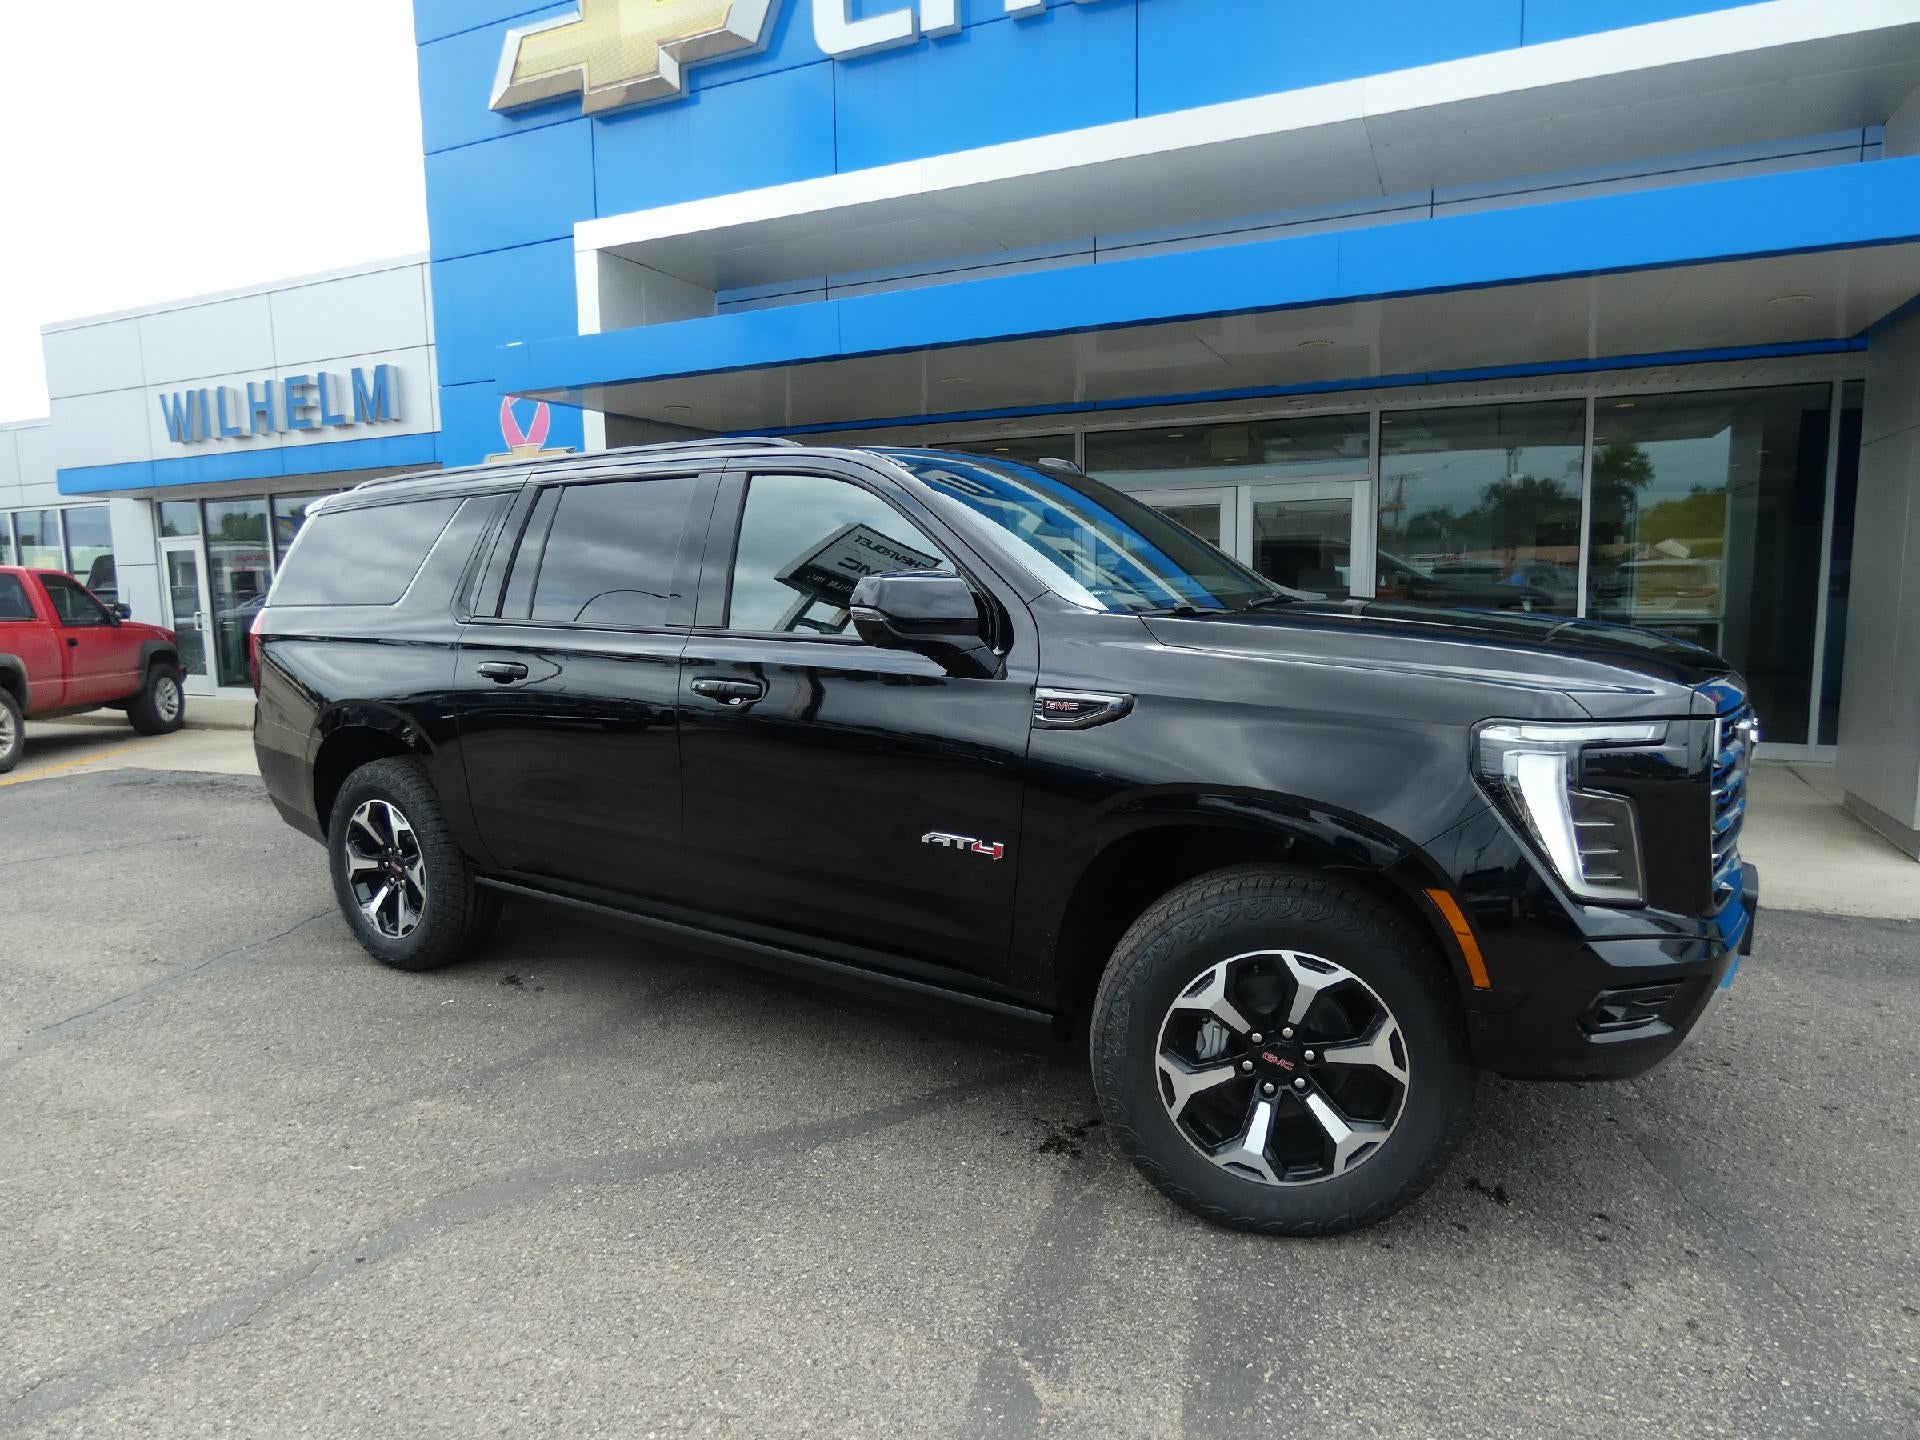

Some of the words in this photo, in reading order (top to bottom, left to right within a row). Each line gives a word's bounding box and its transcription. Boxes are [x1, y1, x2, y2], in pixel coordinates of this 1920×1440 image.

[159, 364, 399, 443] WILHELM
[1045, 699, 1079, 711] GMC
[921, 831, 1004, 860] AT4
[1262, 1051, 1295, 1071] GMC
